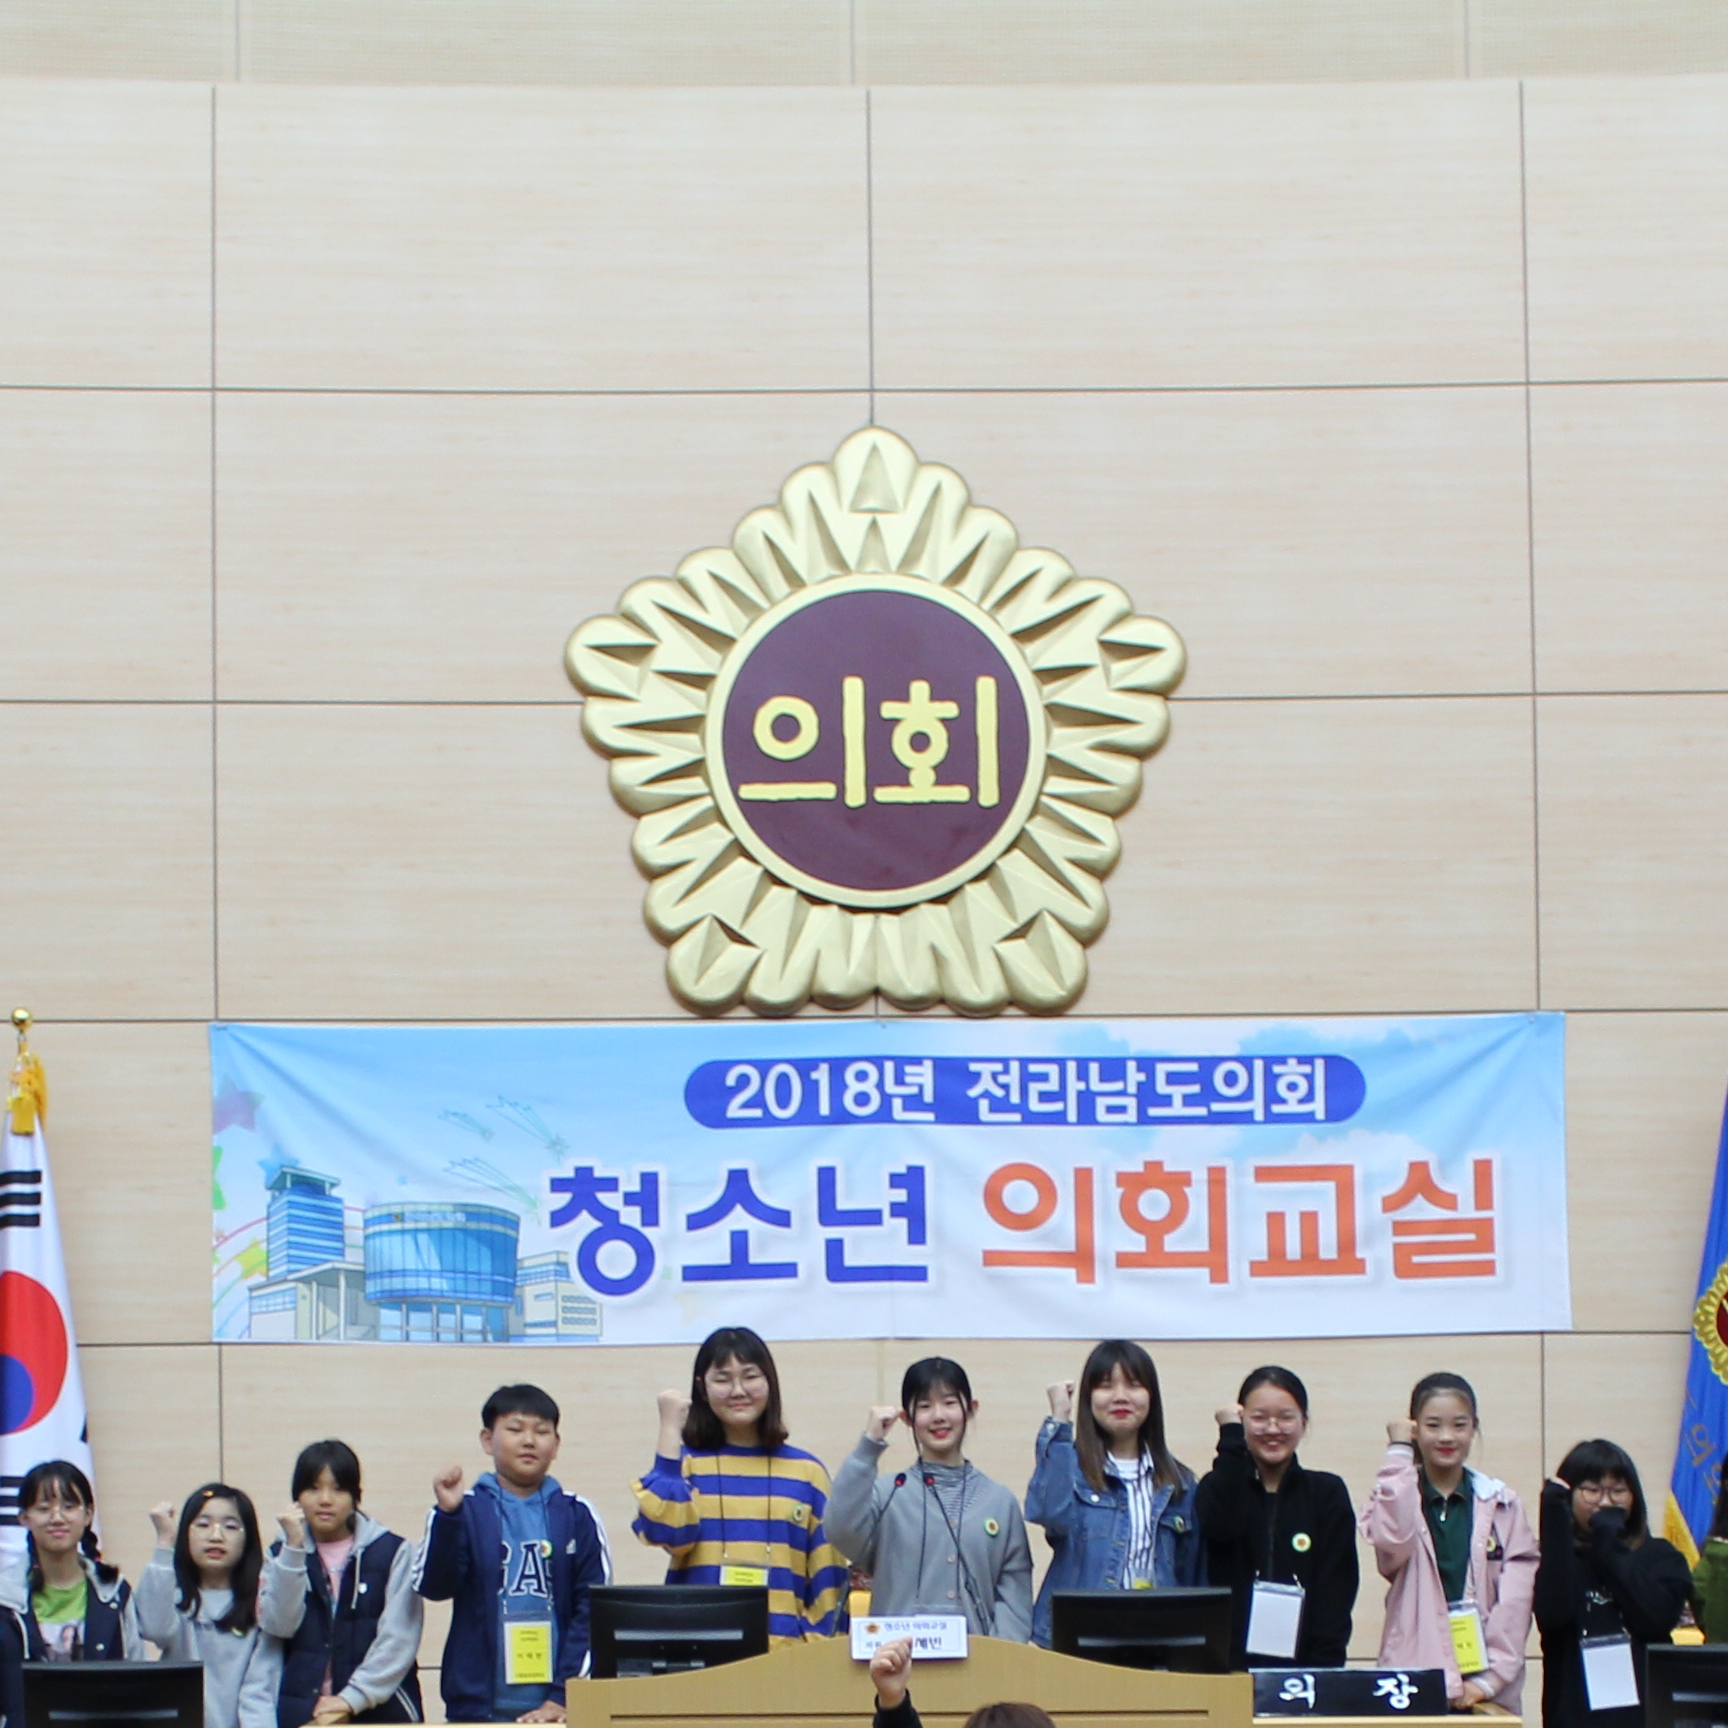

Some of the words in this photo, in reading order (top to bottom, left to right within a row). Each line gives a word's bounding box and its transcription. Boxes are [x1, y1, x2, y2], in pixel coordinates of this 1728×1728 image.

[738, 676, 998, 809] 의회
[724, 1058, 936, 1124] 2018년
[966, 1056, 1329, 1125] 전라남도의회
[547, 1163, 929, 1297] 청소년
[981, 1157, 1498, 1287] 의회교실
[1279, 1673, 1316, 1709] 의
[1373, 1672, 1419, 1710] 장
